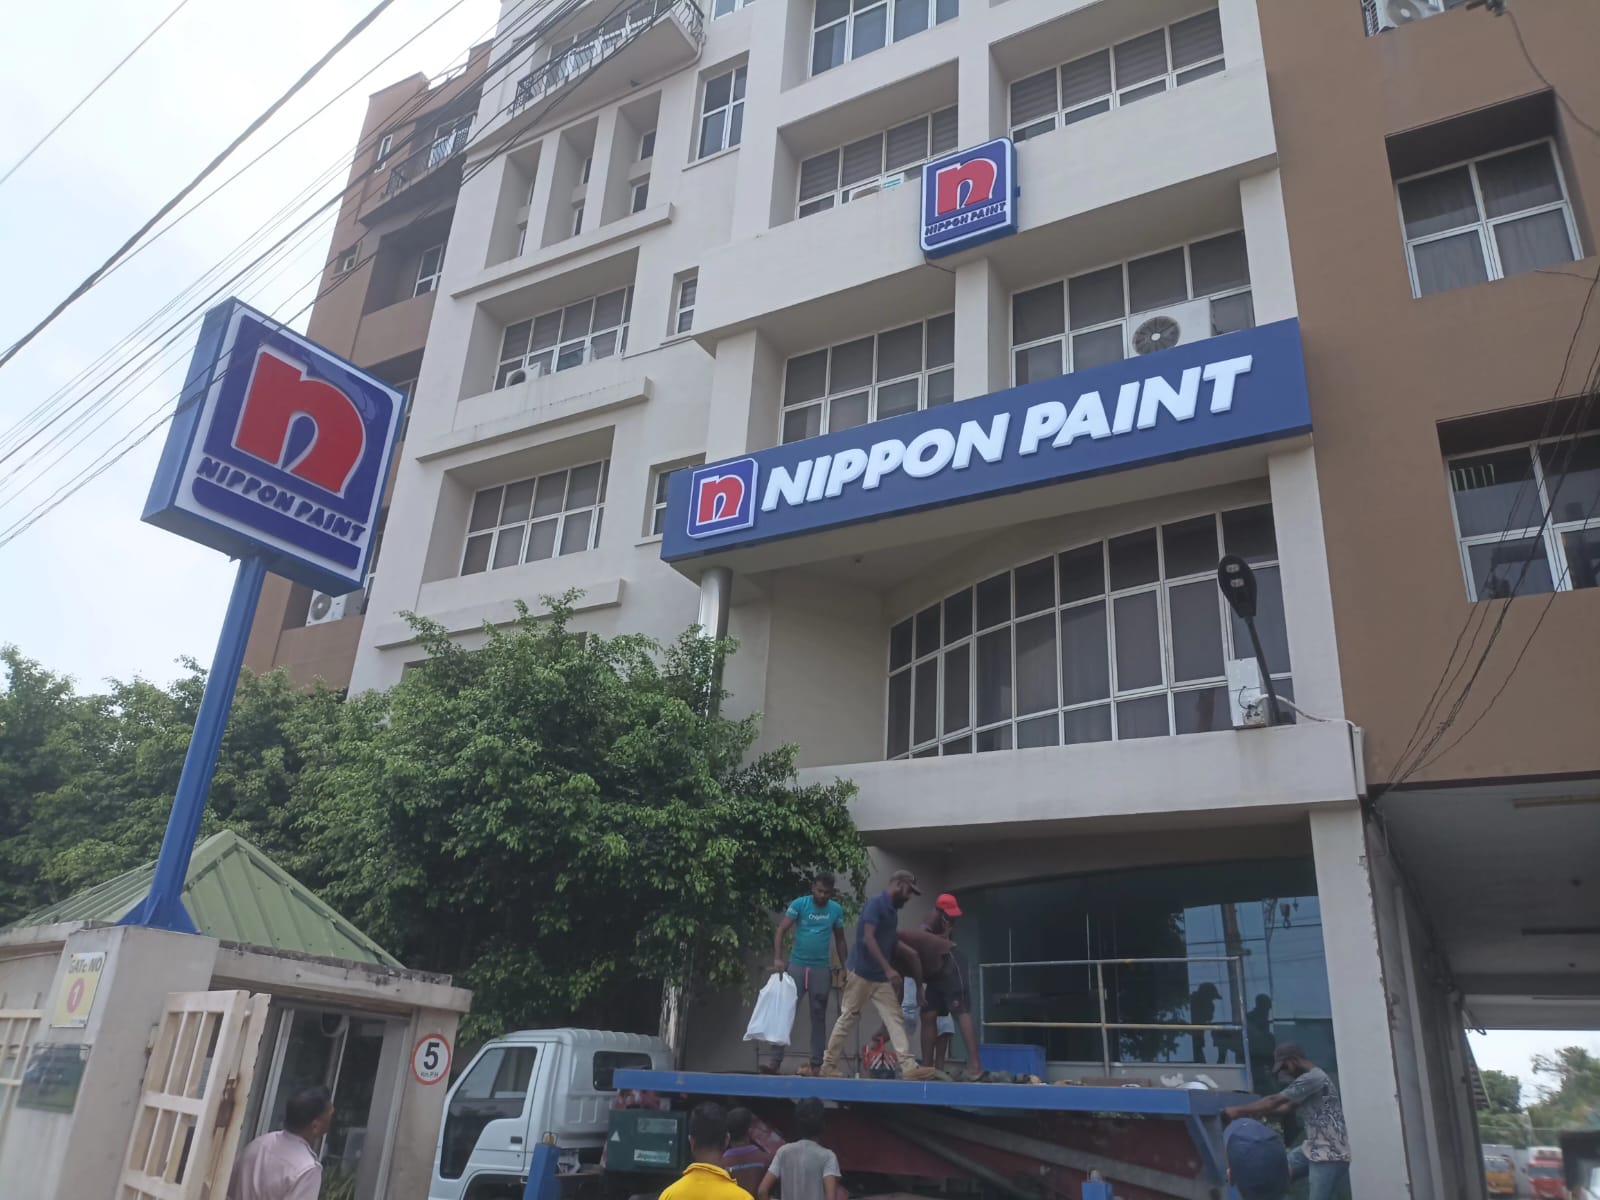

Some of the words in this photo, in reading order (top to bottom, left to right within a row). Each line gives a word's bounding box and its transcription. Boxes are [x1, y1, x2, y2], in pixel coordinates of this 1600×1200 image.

[924, 214, 969, 236] NIPPON
[970, 202, 1006, 221] PAINT
[760, 412, 1012, 513] NIPPON
[1018, 354, 1254, 456] PAINT
[196, 456, 296, 513] NIPPON
[294, 497, 367, 543] PAINT
[423, 1041, 440, 1070] 5
